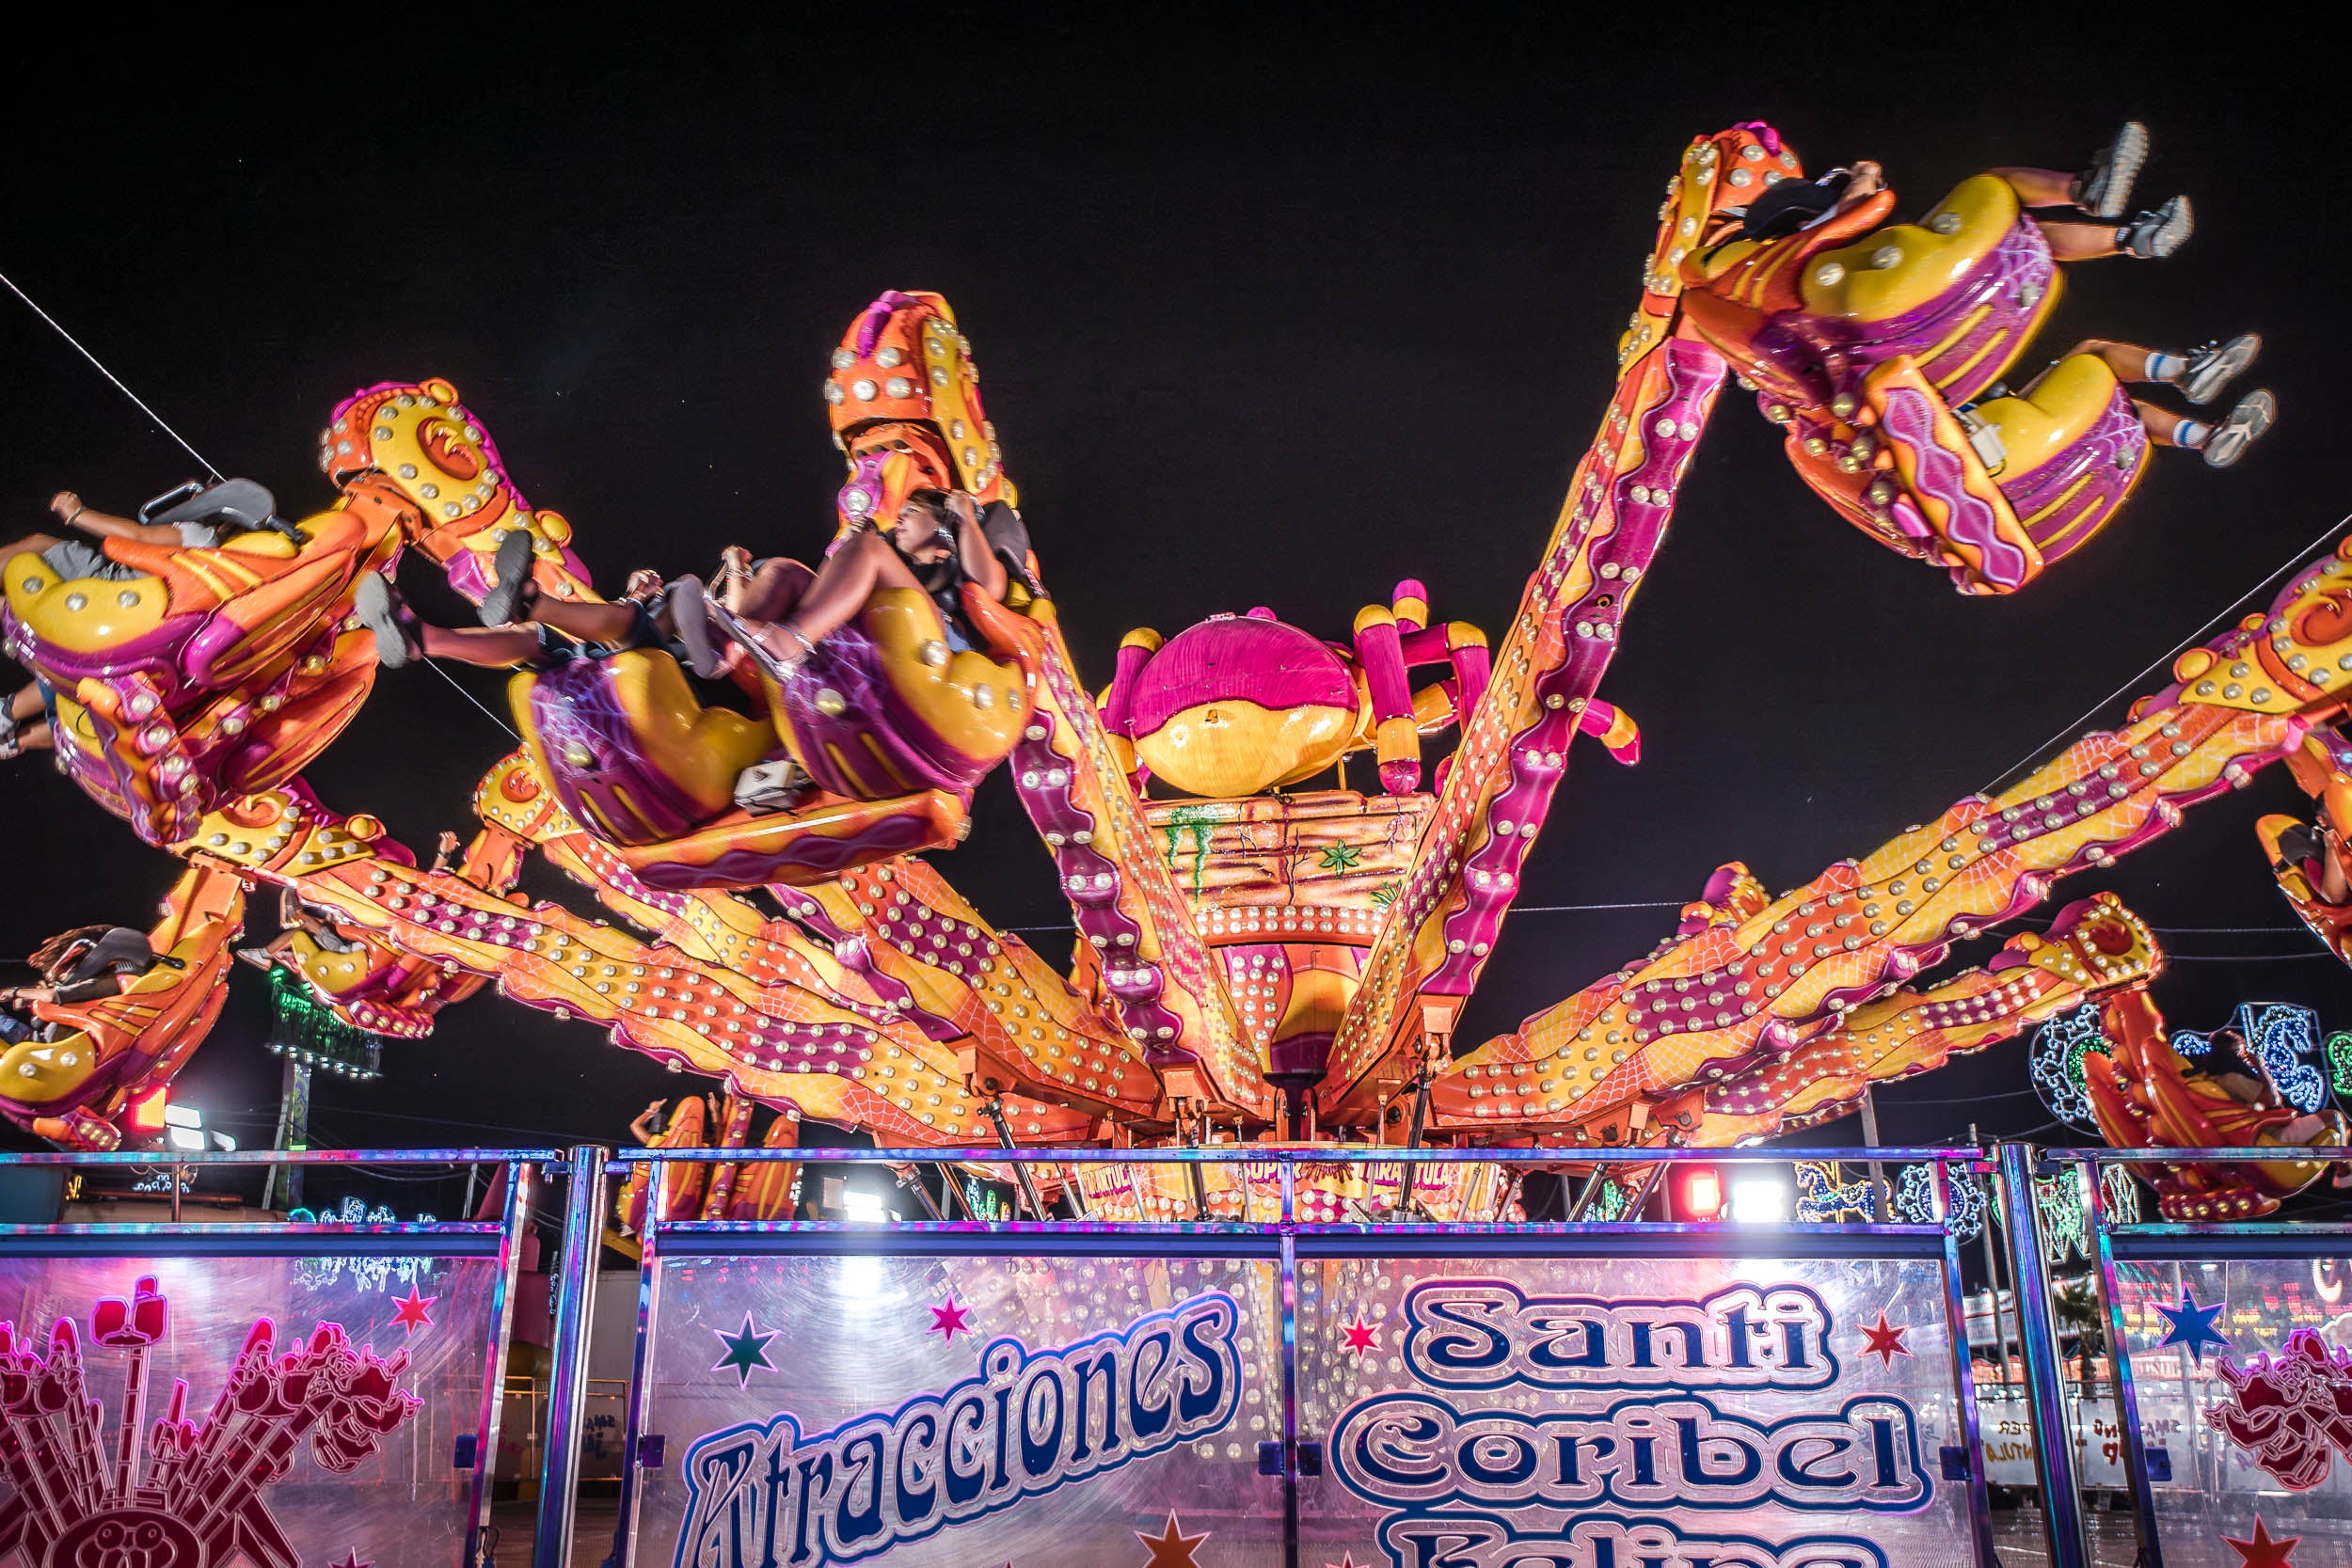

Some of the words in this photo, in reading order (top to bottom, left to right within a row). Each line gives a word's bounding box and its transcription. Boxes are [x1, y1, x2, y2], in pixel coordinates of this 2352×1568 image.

[1415, 1292, 1827, 1380] Santi
[685, 1301, 1231, 1568] Atracciones
[1347, 1402, 1919, 1499] Coribel
